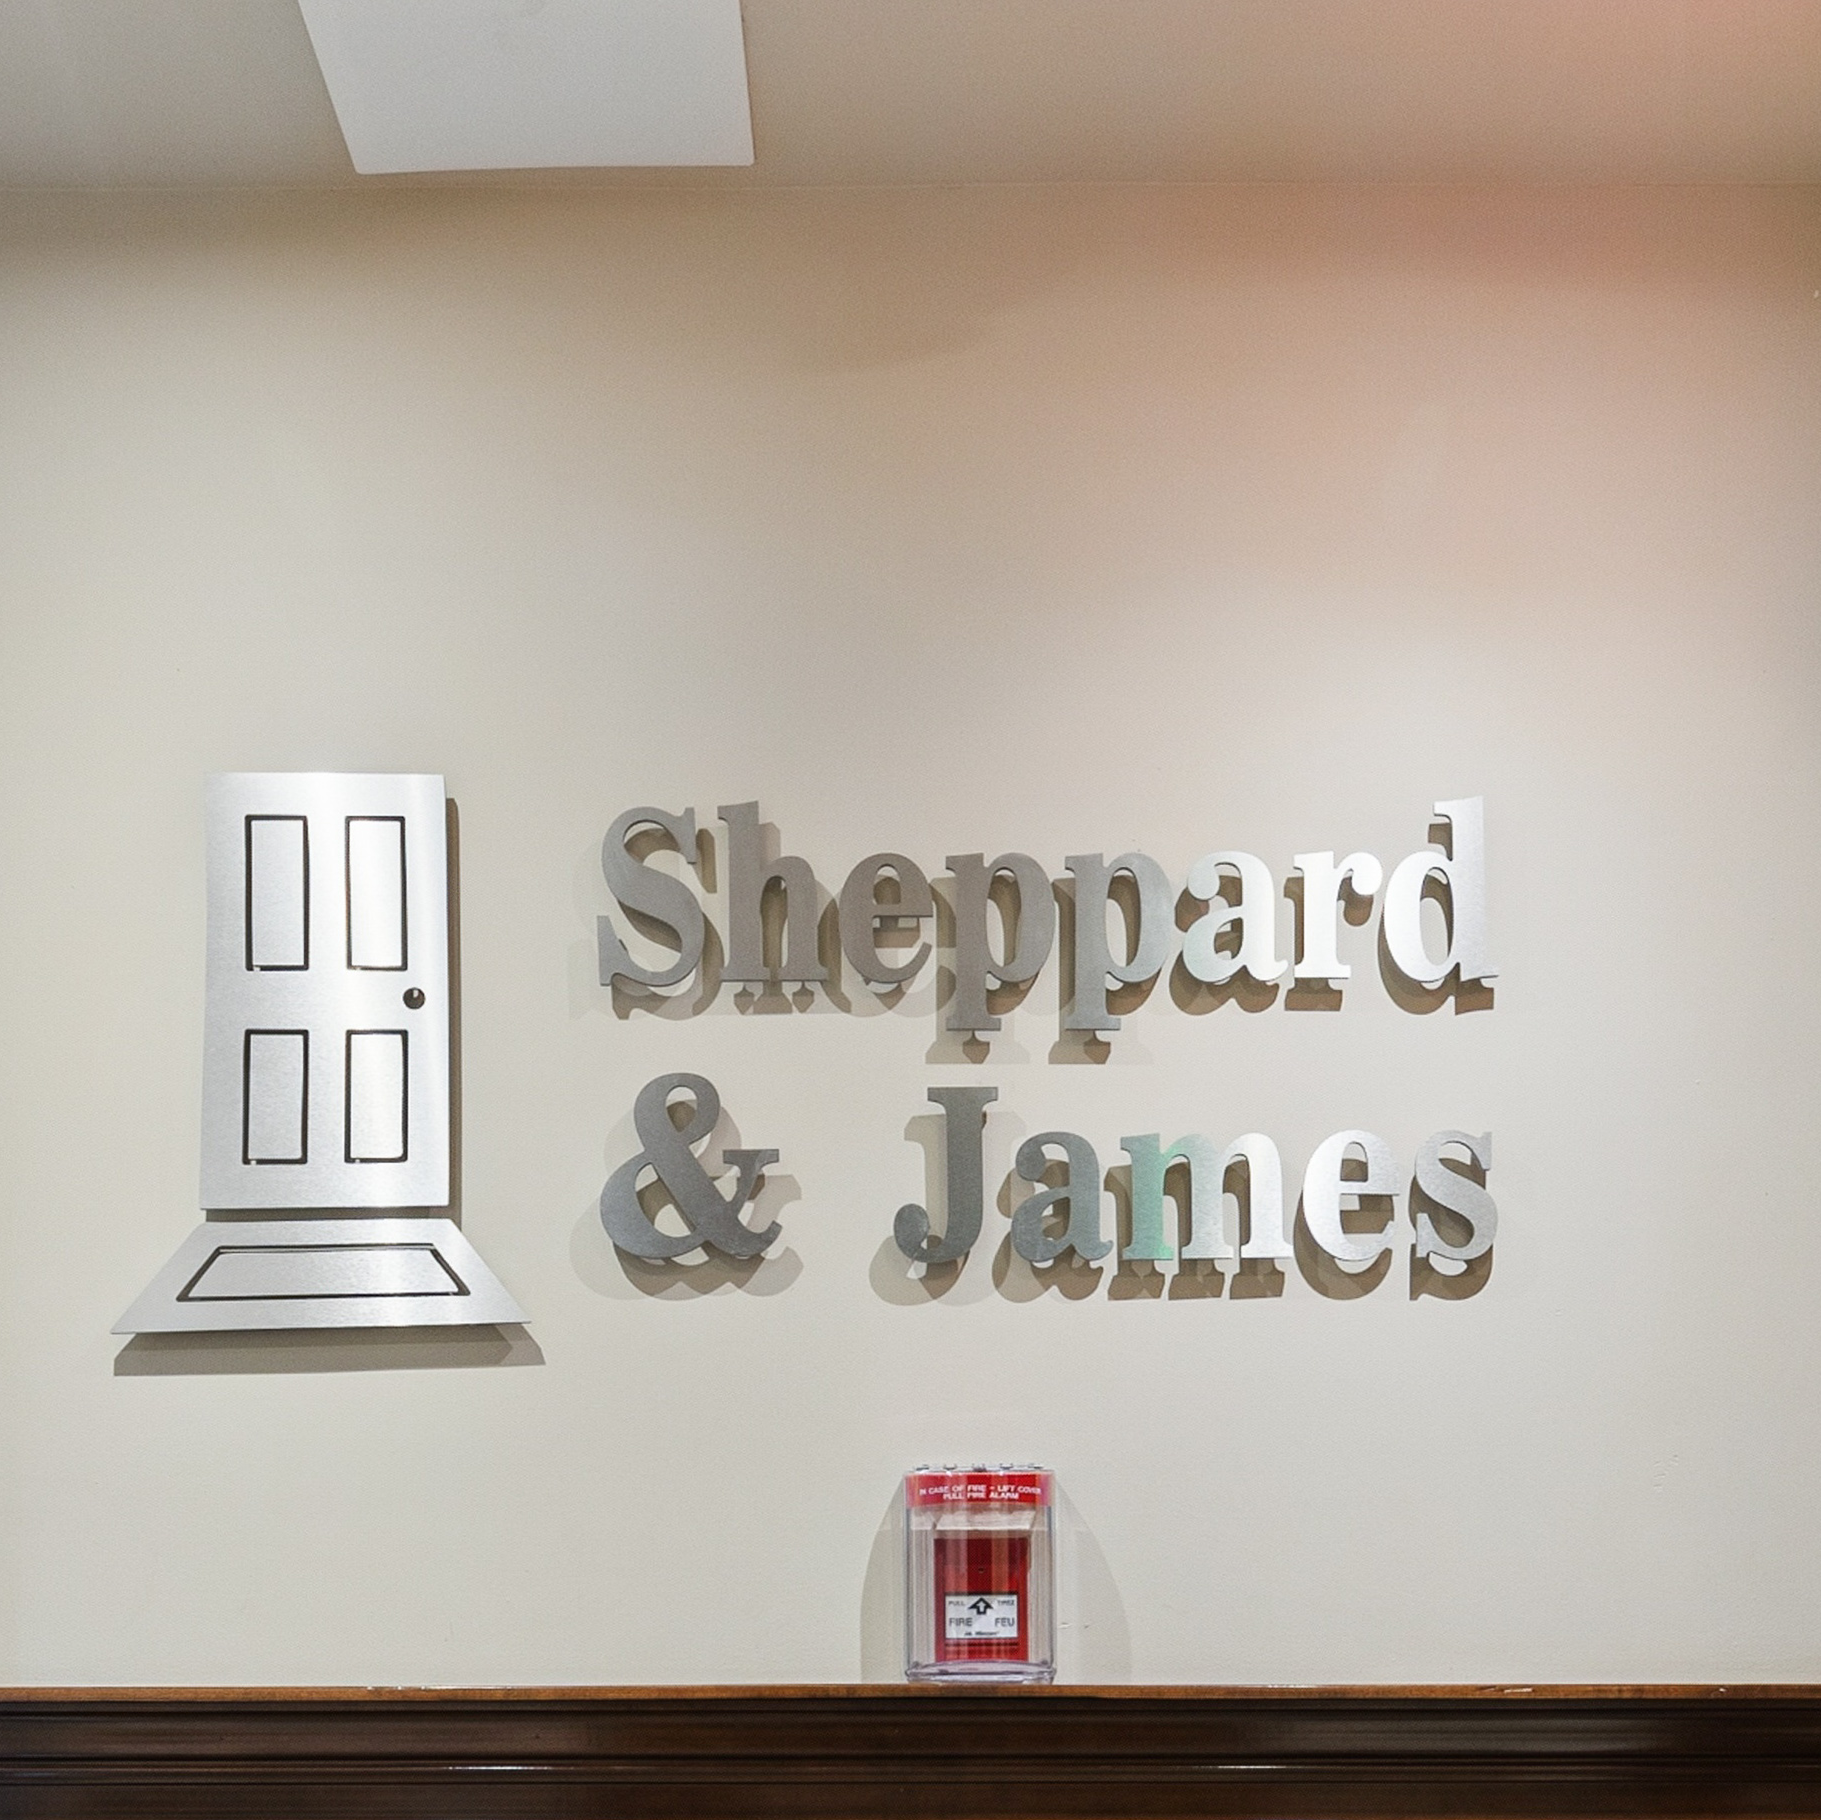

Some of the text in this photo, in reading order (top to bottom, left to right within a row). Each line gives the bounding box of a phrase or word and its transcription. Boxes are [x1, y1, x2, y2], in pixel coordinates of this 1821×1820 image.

[597, 795, 1499, 1032] Sheppard
[599, 1072, 1498, 1262] & James
[929, 1485, 948, 1494] CASE
[967, 1484, 986, 1492] FIRE
[988, 1491, 1020, 1500] ALARM
[949, 1617, 973, 1627] FIRE
[994, 1617, 1015, 1627] FEU
